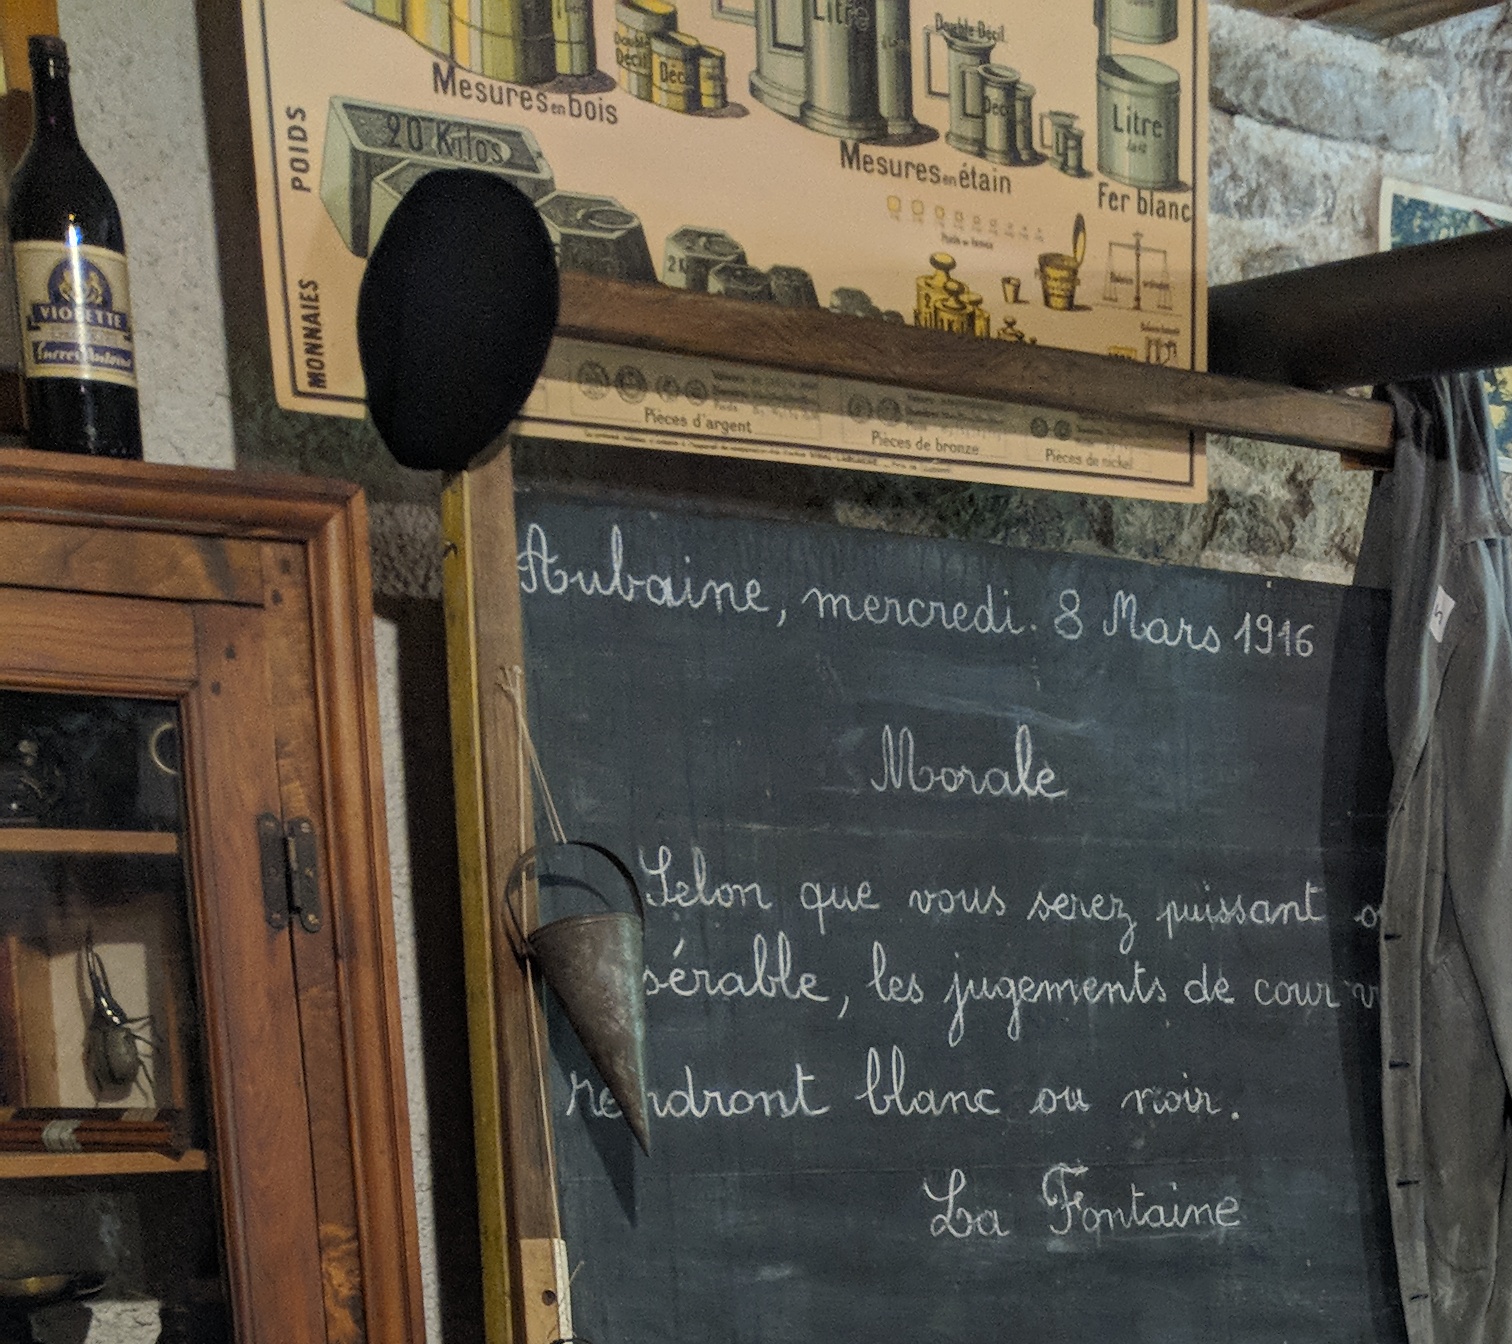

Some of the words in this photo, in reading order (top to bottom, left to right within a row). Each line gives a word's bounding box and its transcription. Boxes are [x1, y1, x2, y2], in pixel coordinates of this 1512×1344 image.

[432, 62, 548, 113] Mesures
[551, 102, 566, 116] en
[568, 94, 618, 125] bois
[1112, 103, 1164, 140] Litre
[285, 105, 311, 194] POIDS
[435, 119, 505, 165] Kilos
[839, 139, 942, 183] Mesures
[958, 161, 1012, 195] étain
[1097, 181, 1131, 213] Fer
[1137, 187, 1192, 224] blanc
[40, 305, 122, 329] VIOETTE
[297, 278, 327, 389] MONNAIES
[643, 406, 688, 429] Pièces
[692, 413, 753, 436] d'argent
[915, 435, 932, 452] de
[934, 438, 980, 456] bronze
[517, 522, 788, 628] Aubaine,
[801, 584, 1038, 636] mercredi.
[1053, 588, 1084, 641] 8
[1102, 588, 1223, 655] Mars
[1233, 611, 1315, 658] 1916
[870, 722, 1069, 800] Morale
[638, 844, 774, 909] Selon
[799, 880, 881, 936] que
[908, 884, 1006, 915] vous
[1026, 888, 1138, 957] serez
[1156, 880, 1327, 940] puissant
[1353, 903, 1382, 929] o
[641, 930, 850, 1020] sérable,
[866, 940, 925, 1004] les
[943, 952, 1168, 1048] jugements
[1183, 961, 1236, 1005] de
[1253, 977, 1341, 1009] cour
[854, 1044, 1001, 1118] blanc
[1029, 1087, 1091, 1114] ou
[1121, 1072, 1241, 1121] noir.
[922, 1167, 1011, 1239] La
[1042, 1161, 1243, 1236] Fontaine
